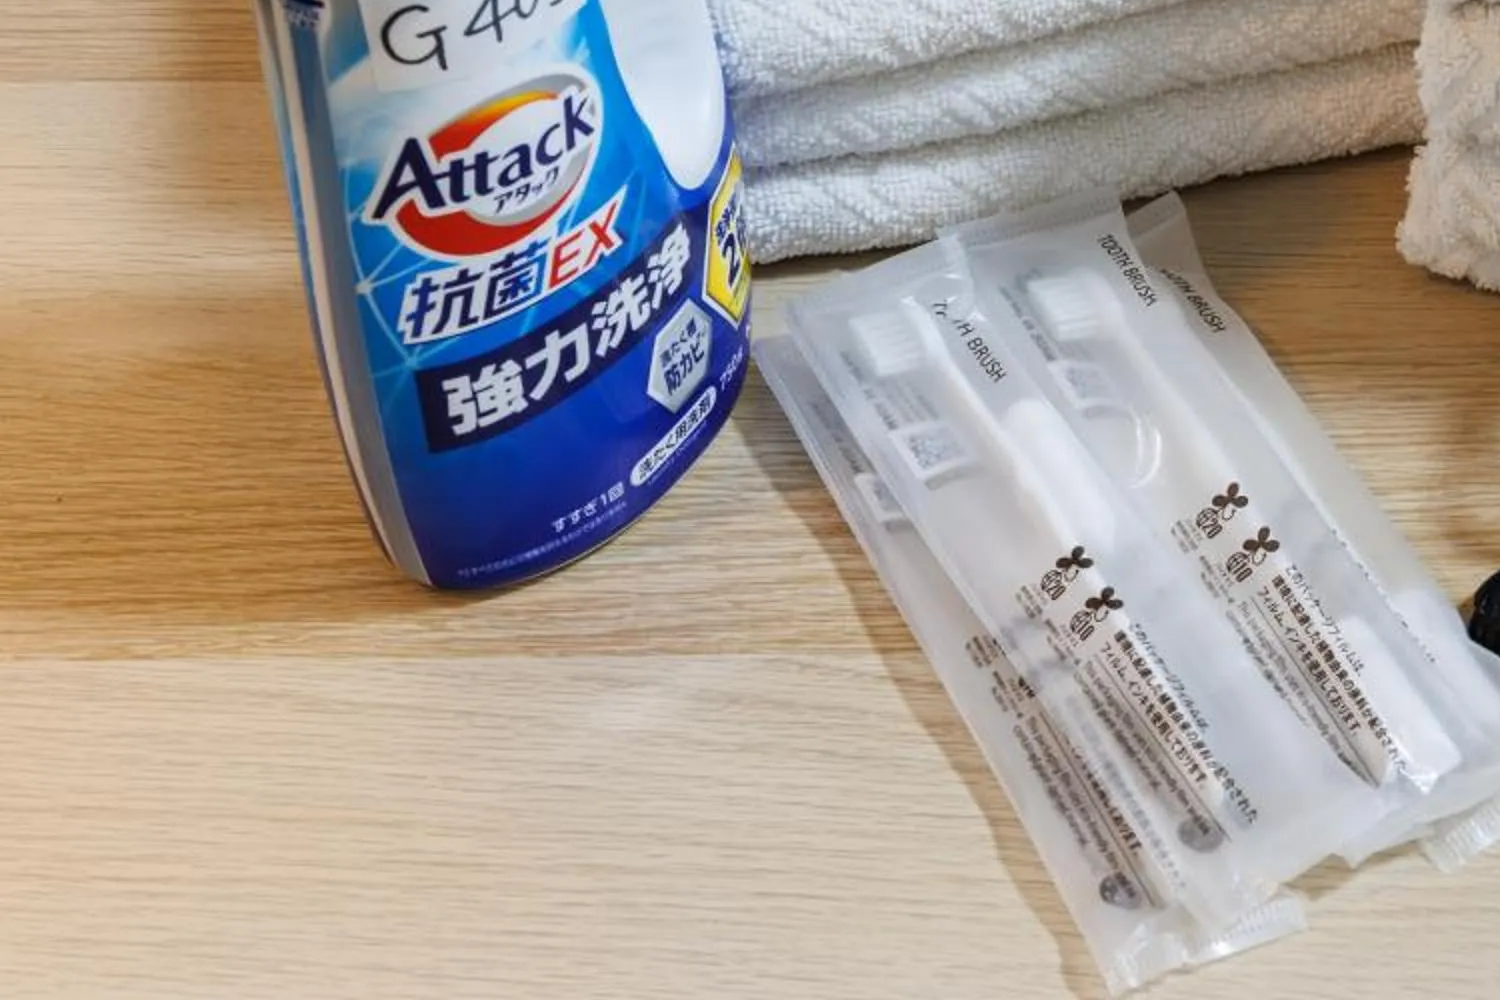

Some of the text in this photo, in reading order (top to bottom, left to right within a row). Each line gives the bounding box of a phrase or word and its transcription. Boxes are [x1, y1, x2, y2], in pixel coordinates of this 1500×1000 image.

[372, 87, 595, 219] Attack
[493, 166, 560, 215] アタック
[1122, 266, 1157, 308] BRUSH
[442, 222, 691, 436] 強力洗浄
[966, 336, 1007, 384] BRUSH
[552, 481, 625, 533] すすぎ1回
